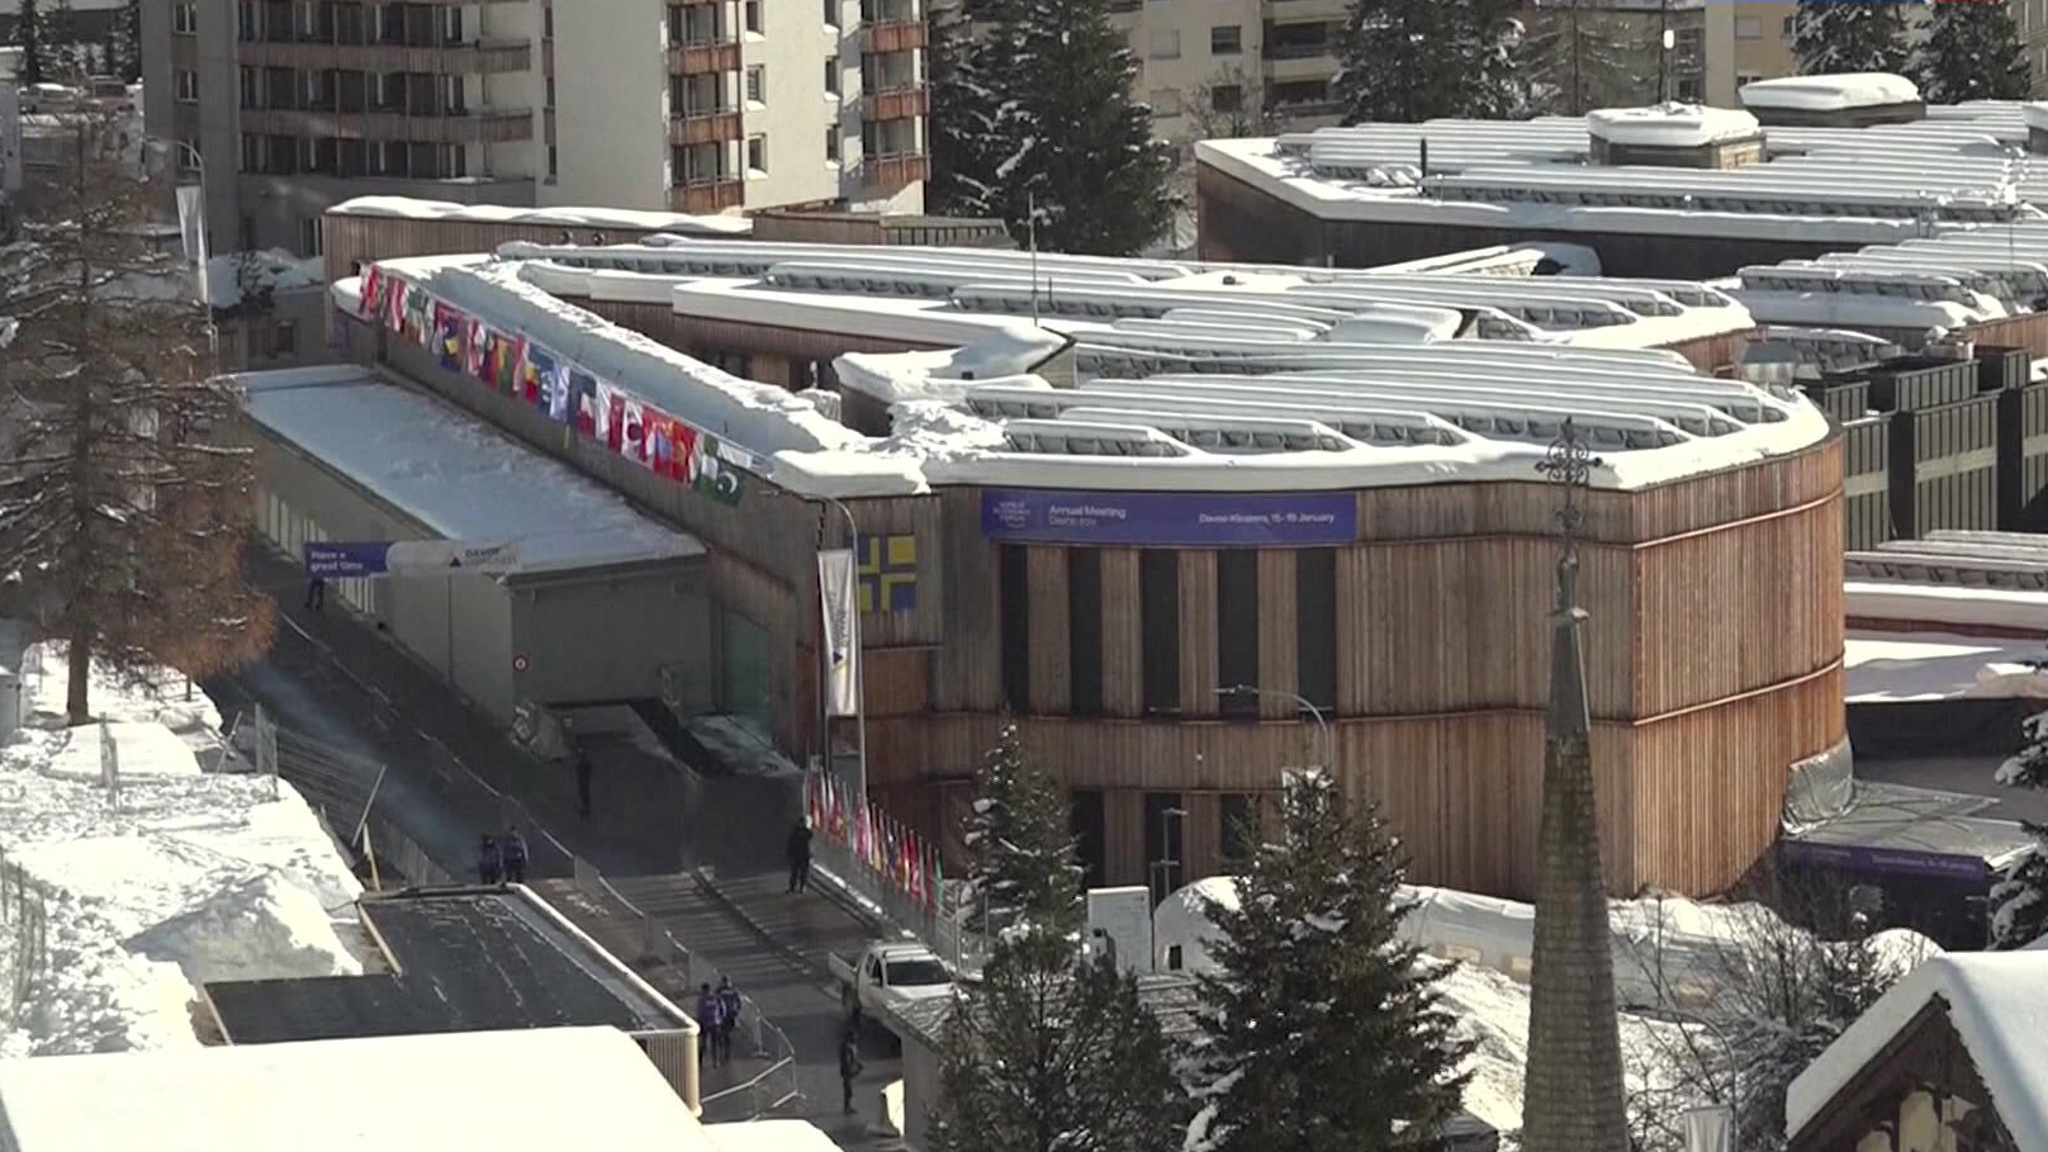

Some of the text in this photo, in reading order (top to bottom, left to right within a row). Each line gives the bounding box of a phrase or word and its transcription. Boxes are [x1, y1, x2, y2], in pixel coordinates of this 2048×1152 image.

[1049, 504, 1127, 520] Annual Meeting
[1299, 512, 1334, 525] January
[310, 560, 338, 573] great
